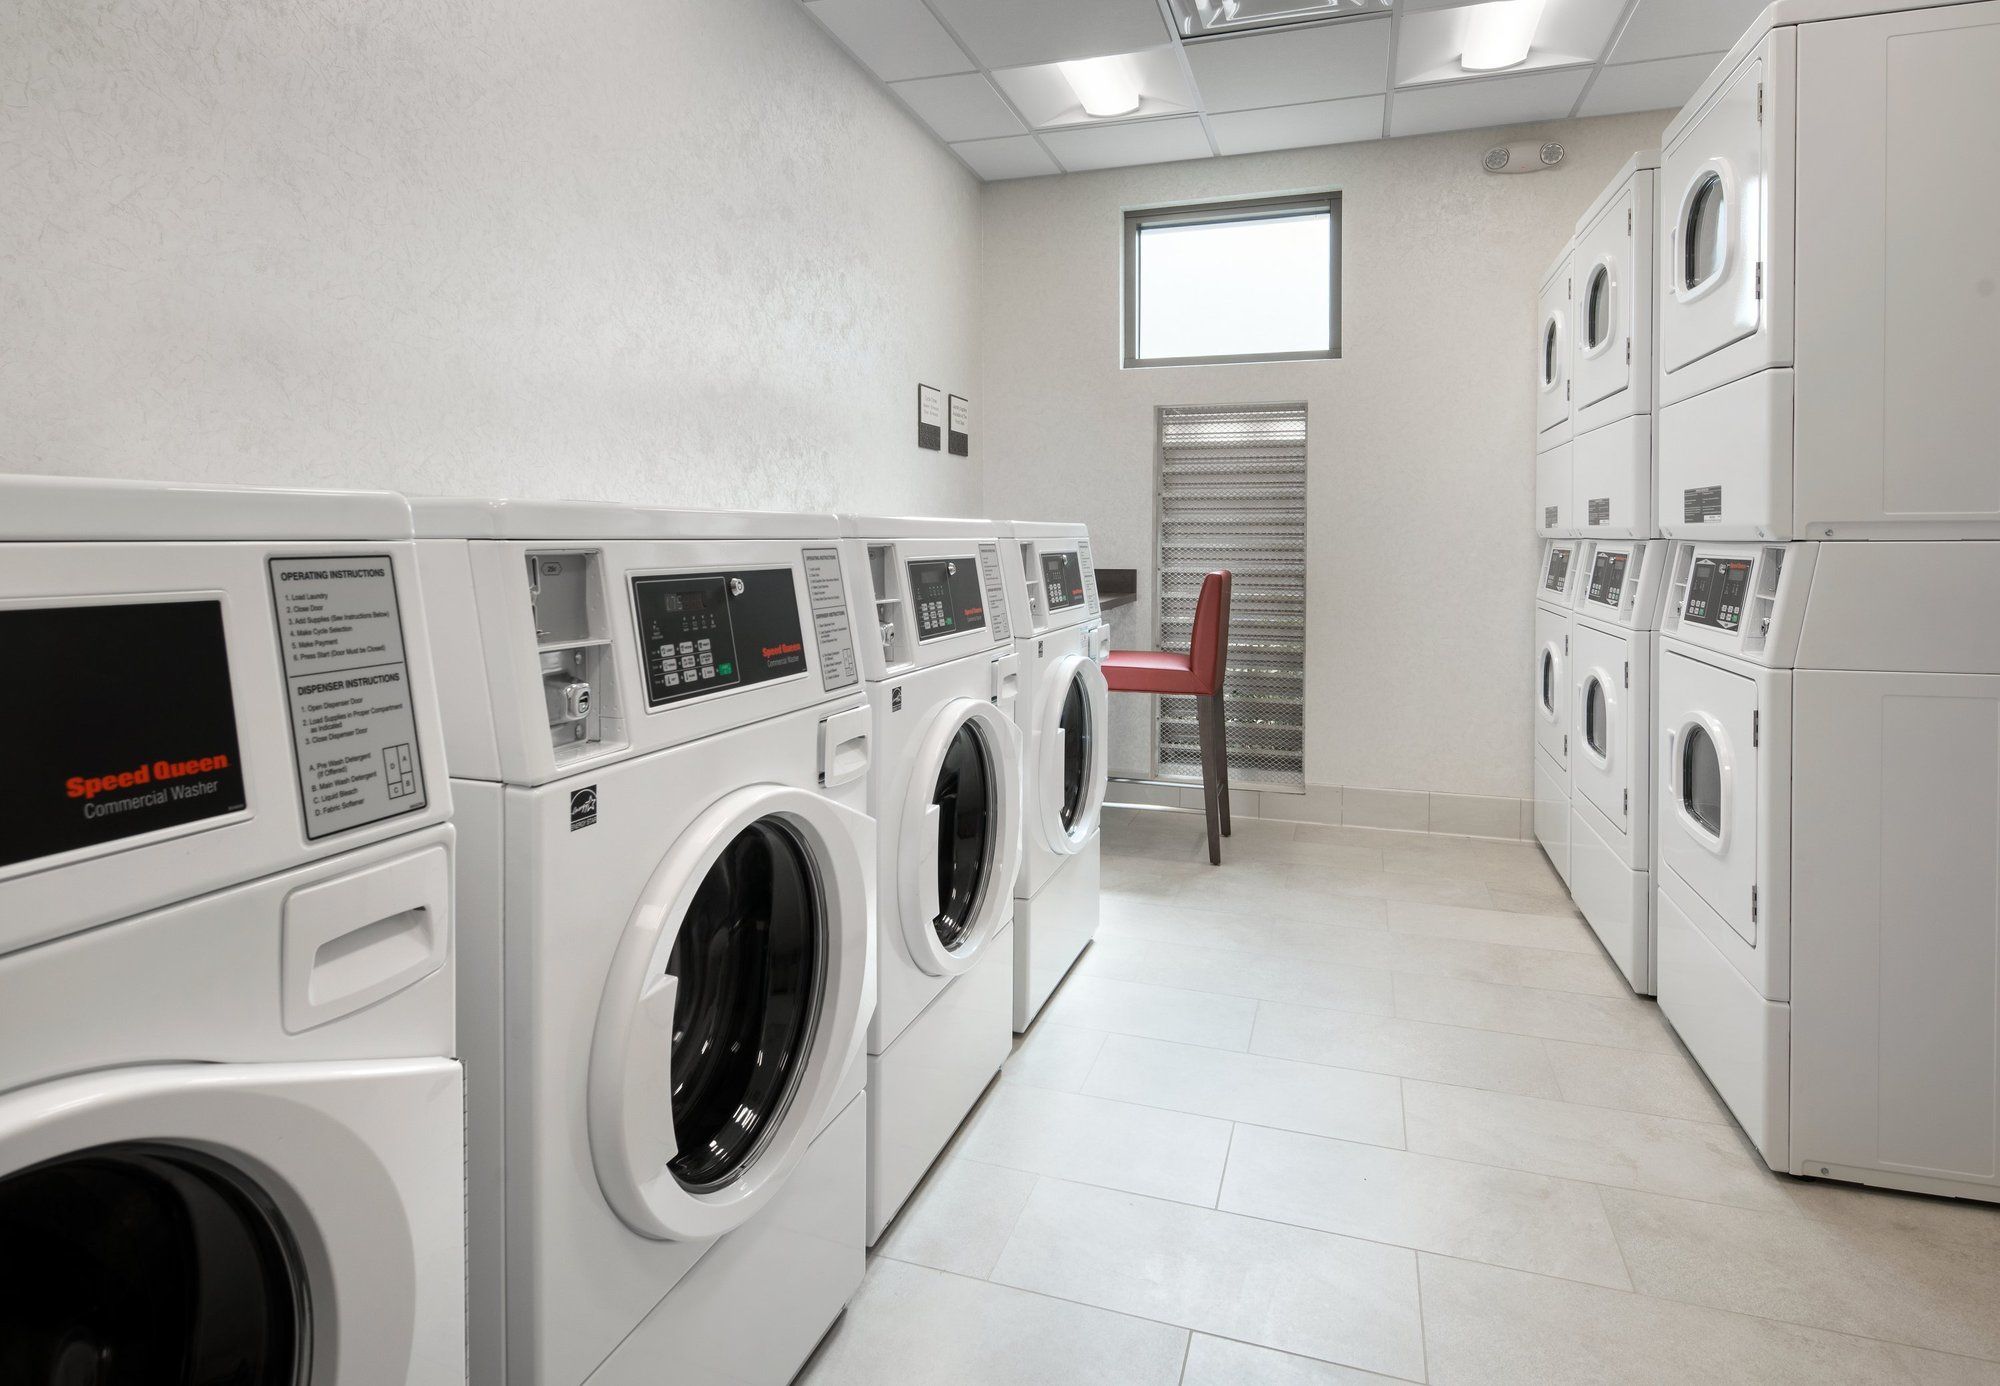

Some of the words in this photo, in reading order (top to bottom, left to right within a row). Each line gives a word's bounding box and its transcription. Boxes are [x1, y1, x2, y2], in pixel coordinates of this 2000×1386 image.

[280, 570, 328, 580] OPERATING
[329, 569, 385, 579] INSTRUCTIONS
[310, 604, 324, 612] Door
[307, 616, 330, 624] Supplies
[312, 628, 328, 636] Cycle
[314, 639, 338, 647] Payment
[330, 650, 344, 658] (Door
[298, 680, 344, 696] DISPENSER
[346, 672, 400, 688] INSTRUCTIONS
[307, 704, 322, 712] Open
[324, 700, 350, 709] Dispenser
[324, 714, 346, 722] Supplies
[370, 704, 403, 714] Compartment
[312, 736, 328, 744] Close
[328, 730, 354, 740] Dispenser
[310, 764, 316, 772] A.
[316, 762, 327, 770] Pre
[328, 759, 344, 767] Wash
[344, 752, 371, 764] Detergent
[390, 762, 396, 770] D
[65, 764, 150, 800] Speed
[152, 754, 228, 781] Queen
[319, 782, 334, 790] Main
[334, 778, 350, 786] Wash
[350, 771, 377, 782] Detergent
[321, 792, 338, 802] Liquid
[339, 788, 358, 797] Bleach
[394, 786, 399, 794] C
[84, 790, 168, 819] Commercial
[170, 780, 218, 800] Washer
[322, 804, 340, 814] Fabric
[342, 799, 364, 809] Softener
